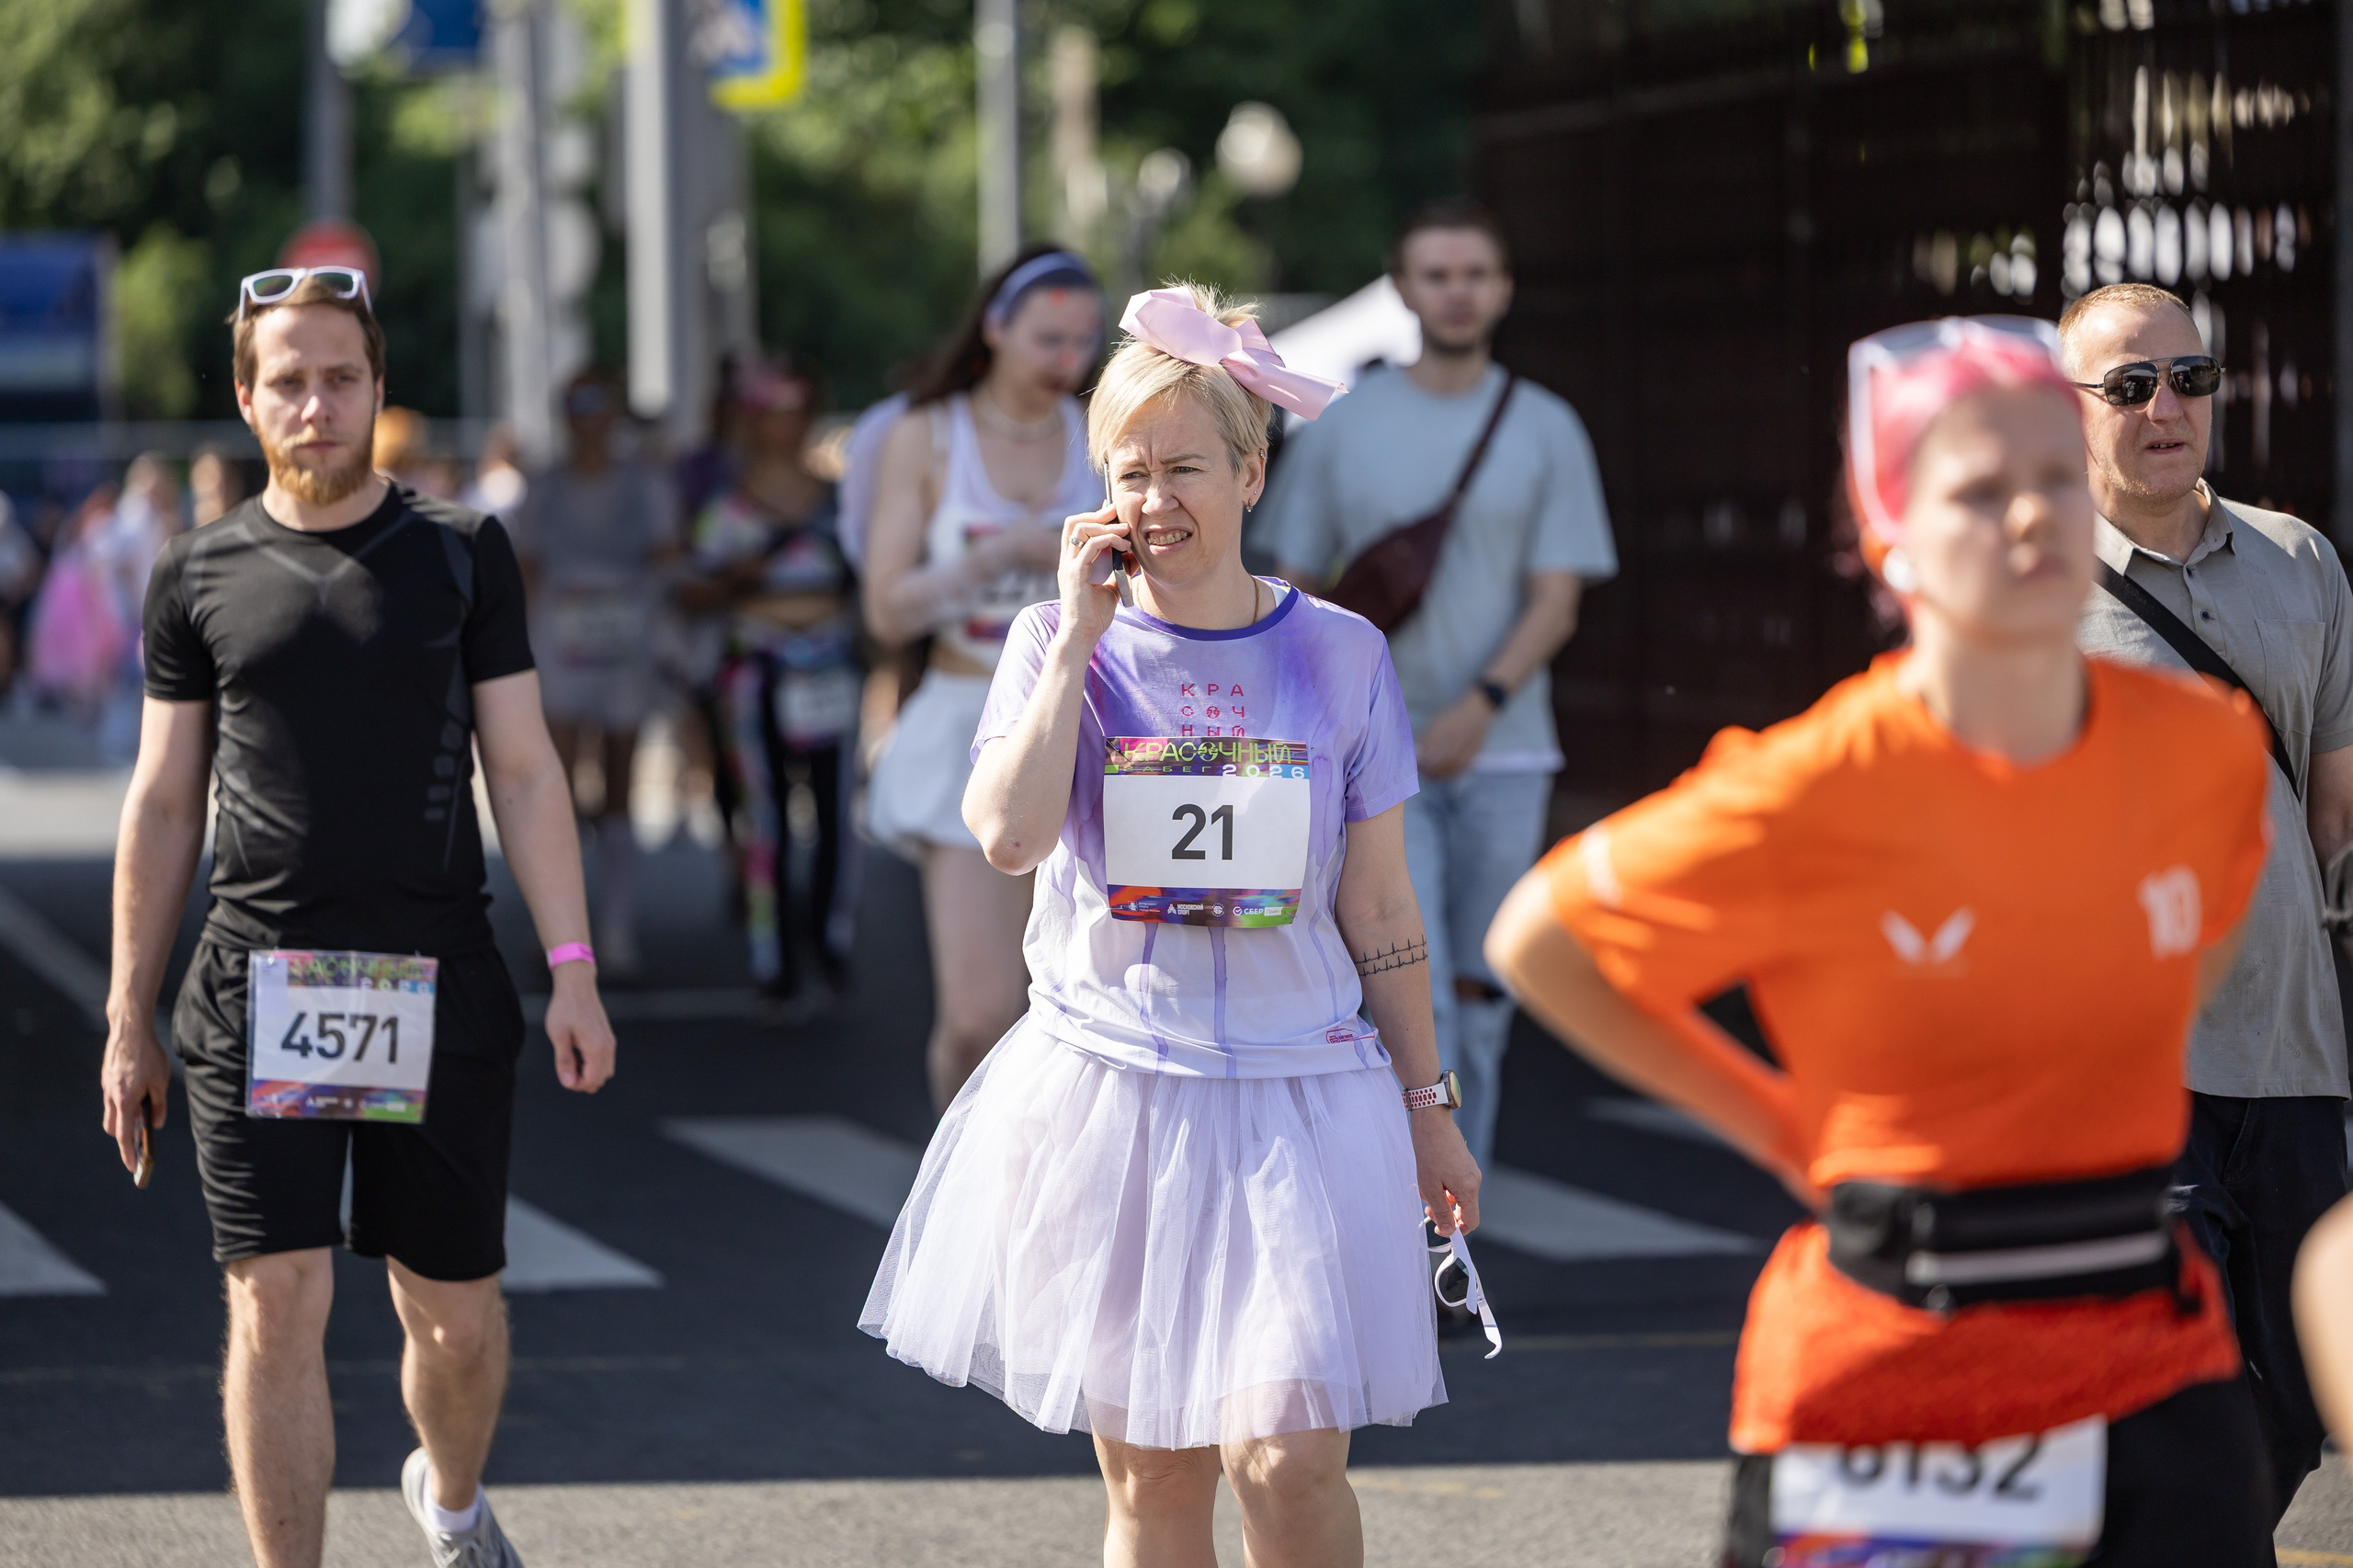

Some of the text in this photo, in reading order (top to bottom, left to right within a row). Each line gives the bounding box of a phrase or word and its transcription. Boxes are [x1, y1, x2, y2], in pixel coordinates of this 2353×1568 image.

[1123, 741, 1291, 764] КРАСОЧНЫЙ
[1123, 764, 1305, 779] ЗАБЕГ 2026
[1172, 803, 1233, 860] 21
[2136, 867, 2202, 959] 10
[281, 1011, 399, 1064] 4571
